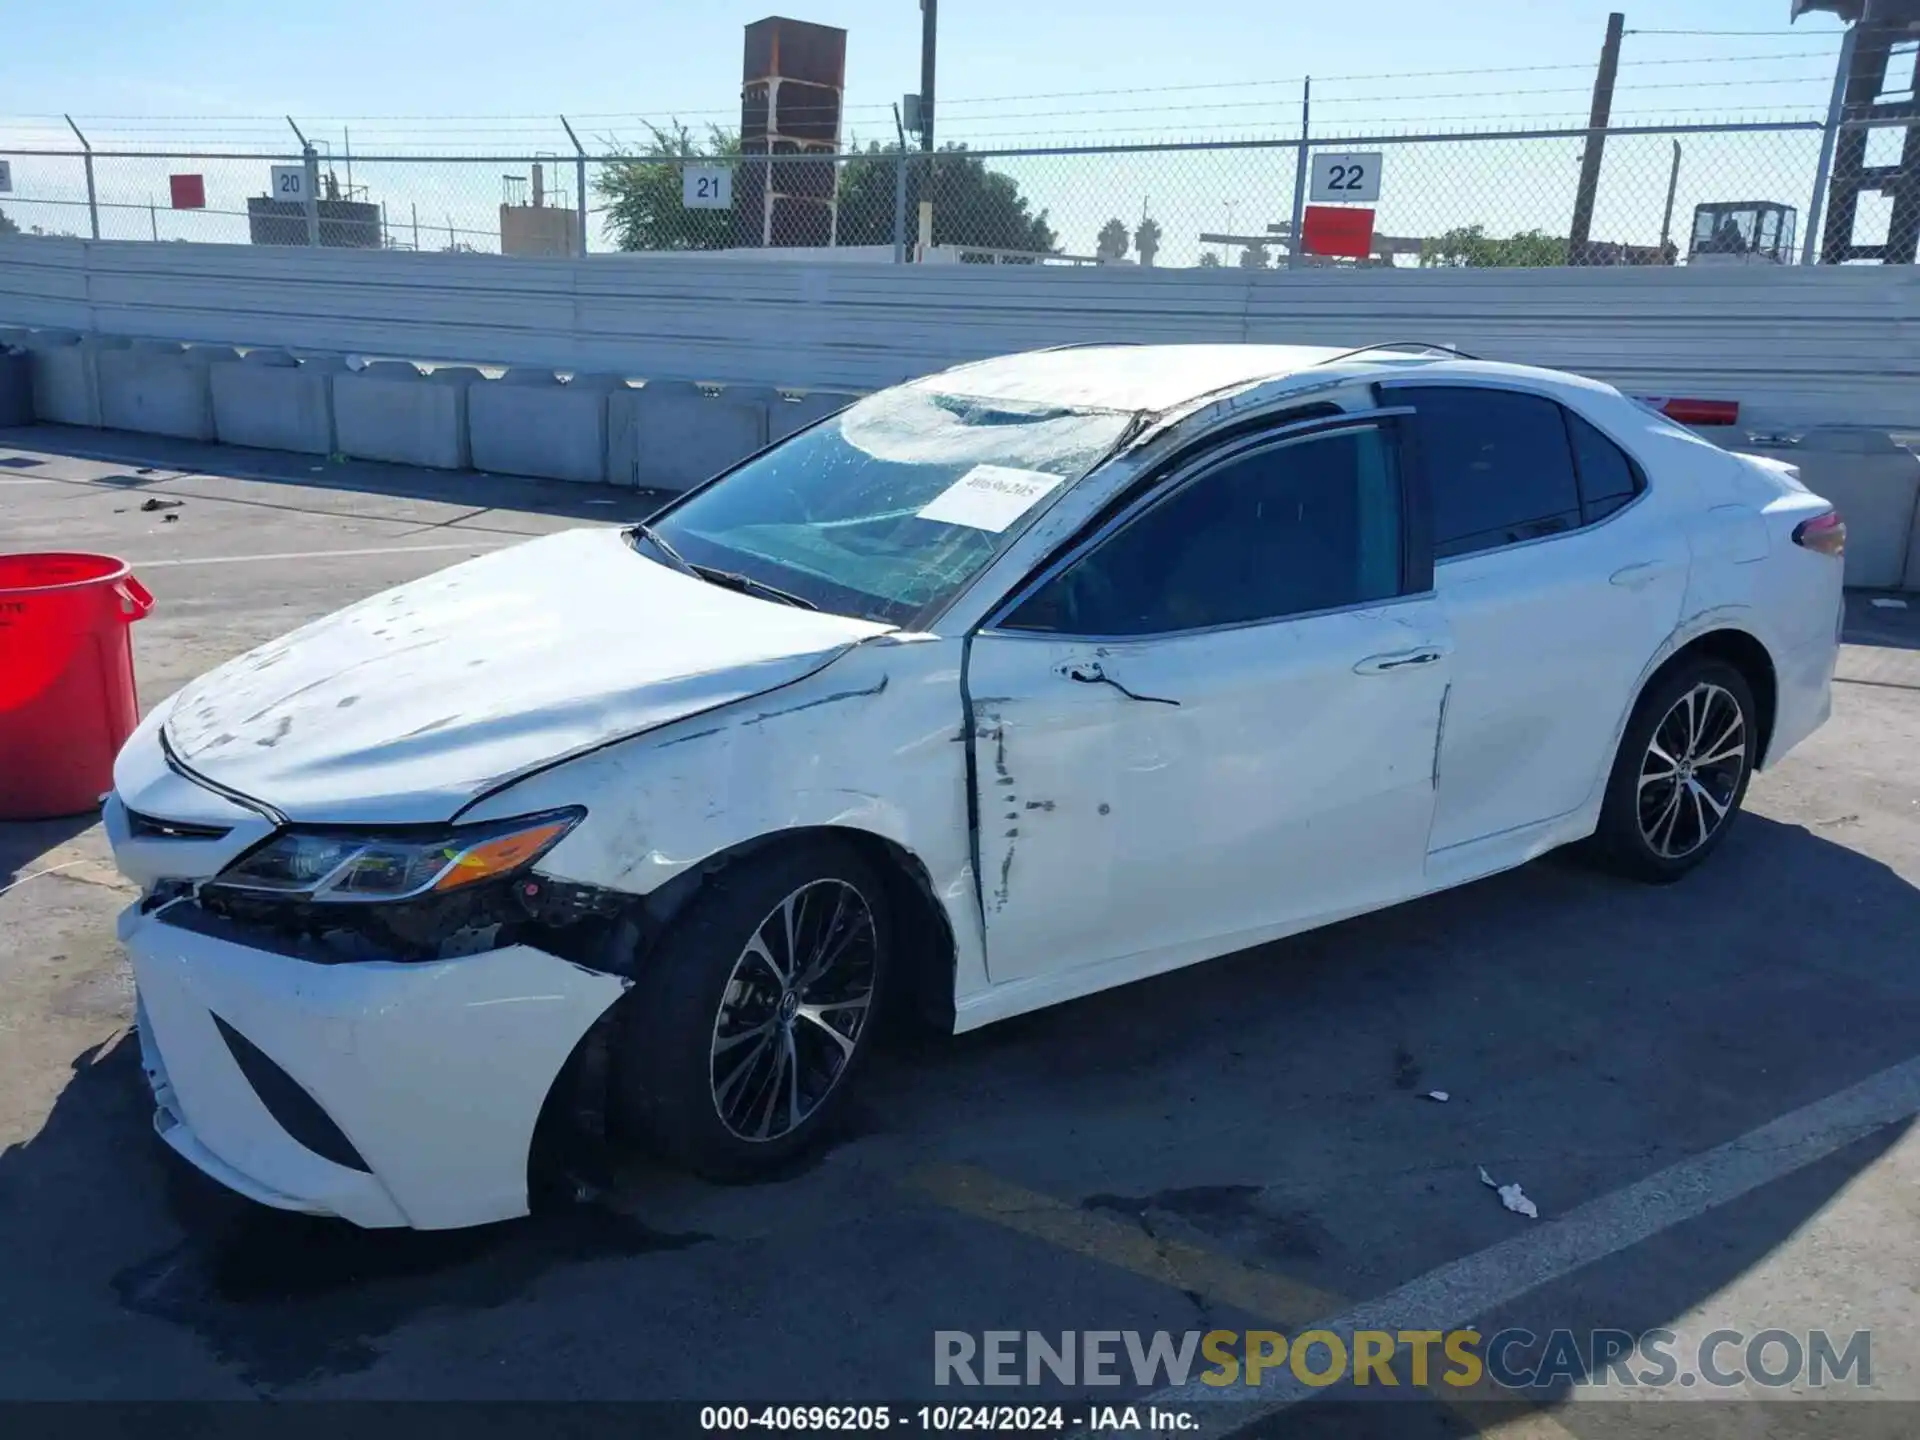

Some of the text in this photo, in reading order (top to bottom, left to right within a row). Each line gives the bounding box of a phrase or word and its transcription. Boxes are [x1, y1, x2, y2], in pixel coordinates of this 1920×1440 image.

[280, 173, 300, 193] 20
[697, 176, 719, 199] 21
[1327, 164, 1364, 190] 22
